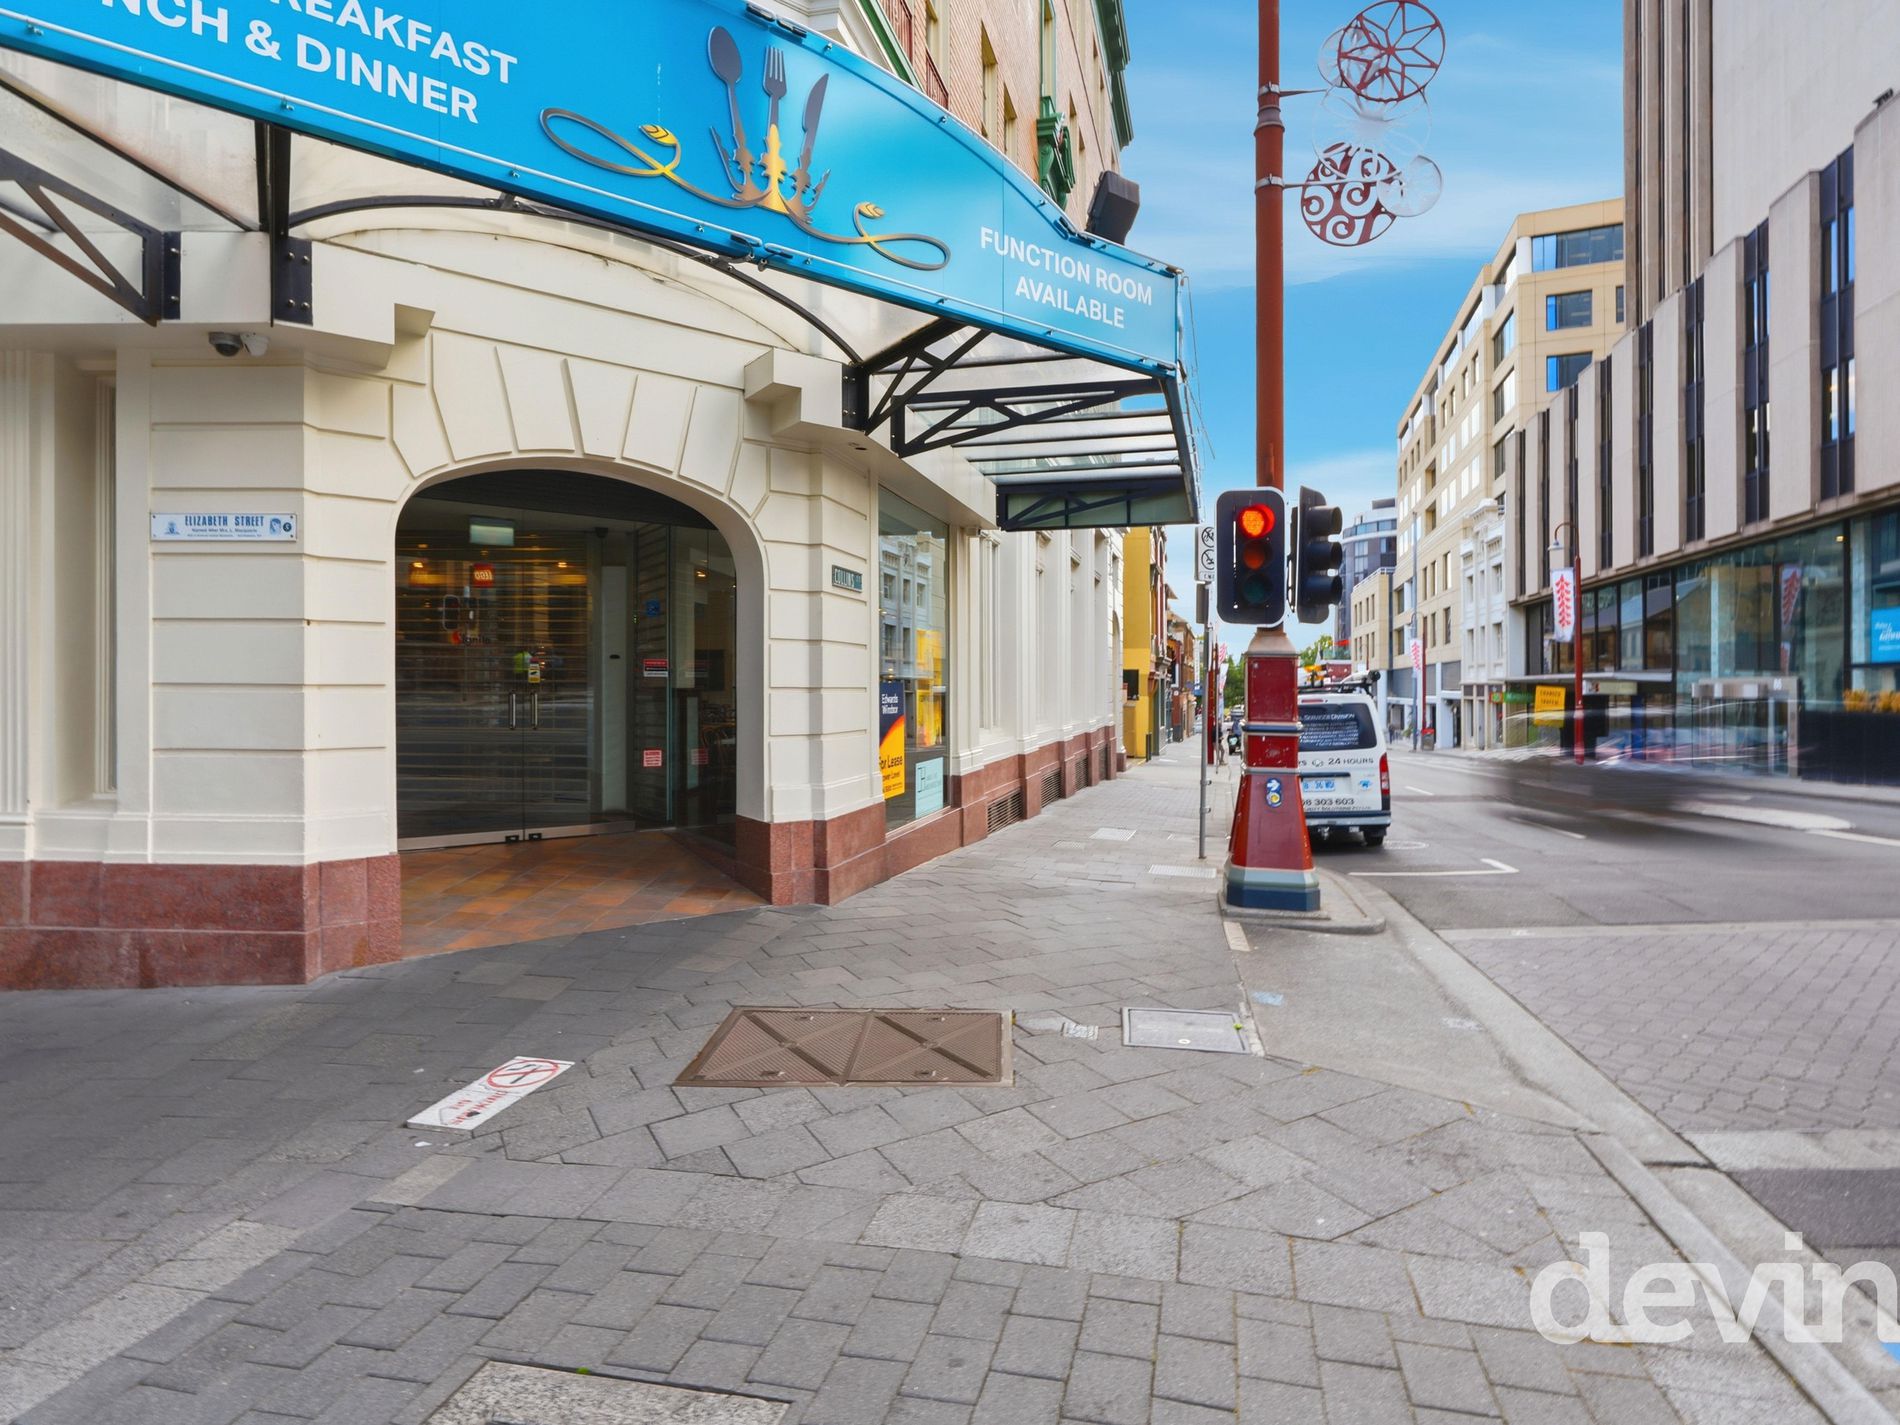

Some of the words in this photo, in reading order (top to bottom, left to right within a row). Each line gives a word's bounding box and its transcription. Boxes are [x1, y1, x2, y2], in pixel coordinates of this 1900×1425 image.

[270, 0, 518, 84] EAKFAST
[244, 19, 282, 61] &
[297, 33, 479, 125] DINNER
[980, 226, 1090, 286] FUNCTION
[1096, 267, 1152, 306] ROOM
[1015, 276, 1125, 329] AVAILABLE
[185, 515, 228, 527] ELIZABETH
[234, 515, 265, 527] STREET
[834, 568, 855, 588] COLLINS
[888, 755, 903, 769] Lease
[1328, 757, 1341, 765] 24
[1343, 757, 1374, 765] HOURS
[1314, 798, 1333, 806] 303
